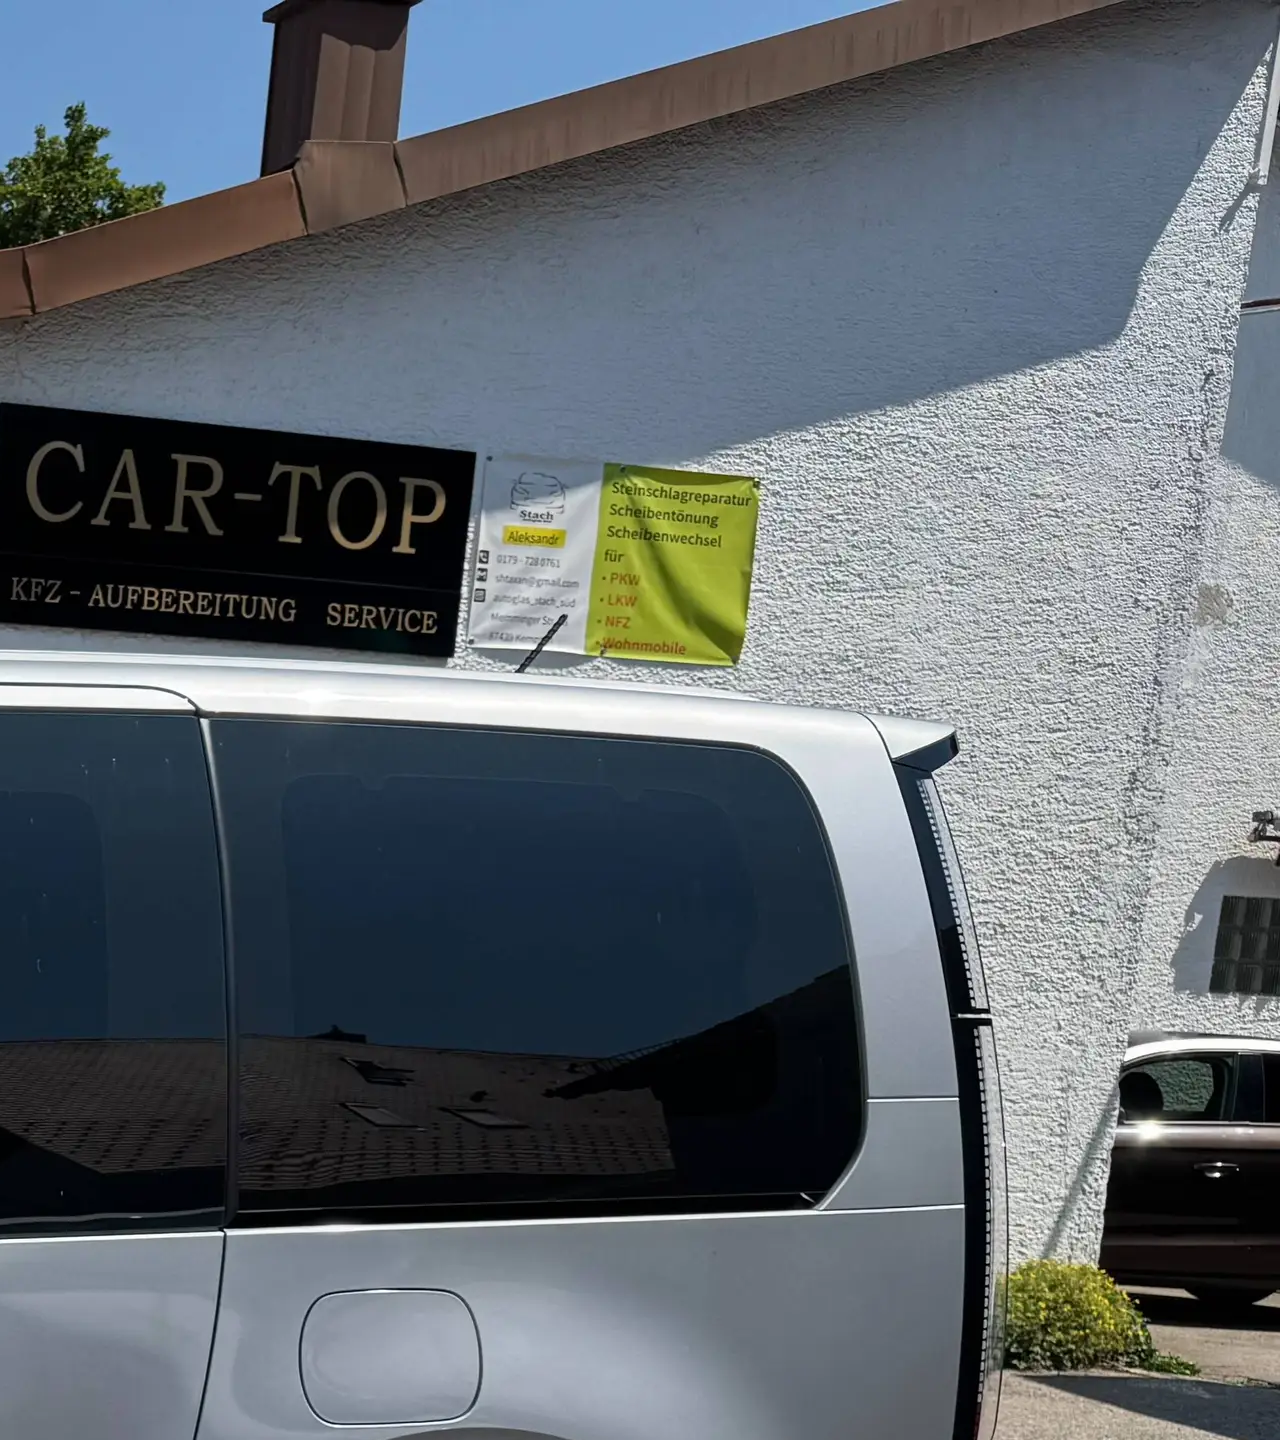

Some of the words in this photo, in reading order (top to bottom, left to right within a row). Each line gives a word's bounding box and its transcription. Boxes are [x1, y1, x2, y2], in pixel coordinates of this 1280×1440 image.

[25, 440, 447, 555] CAR-TOP
[611, 482, 752, 508] Steinschlagreparatur
[519, 510, 554, 521] Stach
[609, 504, 719, 529] Scheibentönung
[506, 530, 560, 545] Aleksandr
[606, 525, 722, 548] Scheibenwechsel
[604, 549, 625, 564] für
[609, 572, 640, 587] PKW
[10, 576, 61, 604] KFZ
[87, 583, 297, 623] AUFBEREITUNG
[326, 603, 439, 635] SERVICE
[607, 594, 638, 608] LKW
[604, 616, 632, 630] NFZ
[601, 636, 688, 656] Wohnmobile
